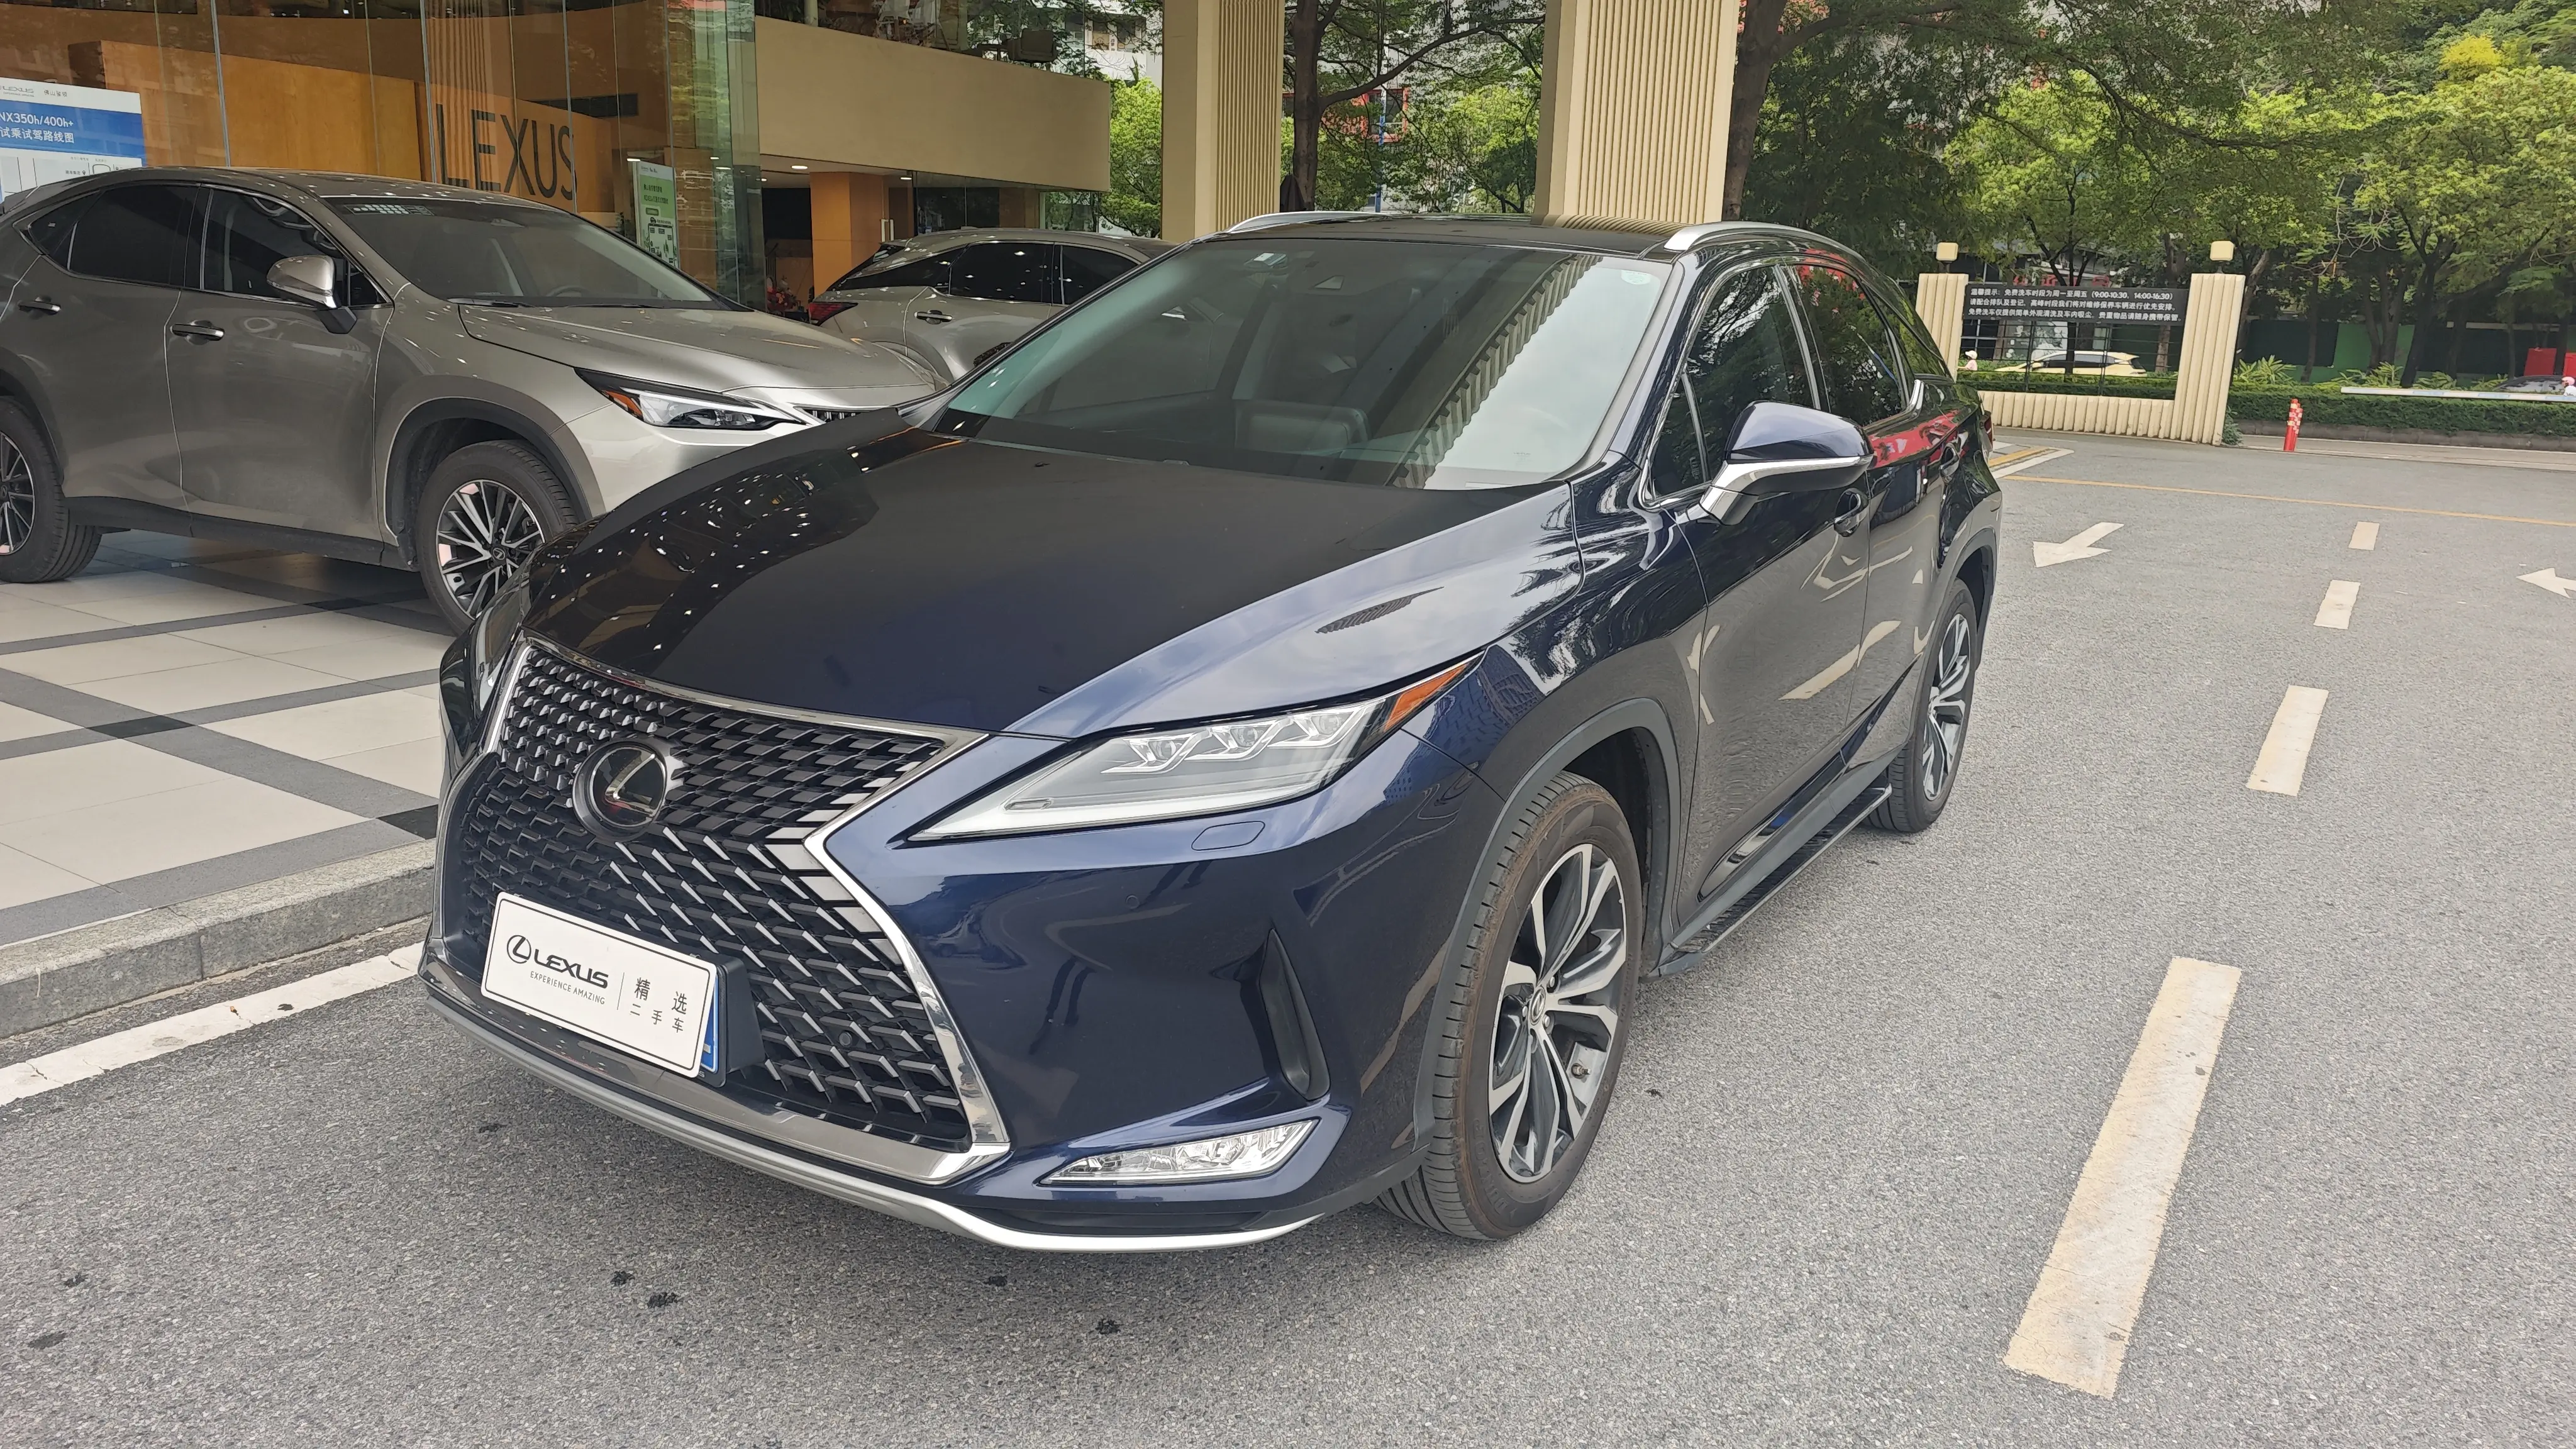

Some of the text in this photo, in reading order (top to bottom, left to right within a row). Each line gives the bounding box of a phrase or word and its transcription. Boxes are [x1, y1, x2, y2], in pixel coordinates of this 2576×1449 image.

[0, 111, 74, 128] NX350h/400h+
[0, 126, 74, 143] 试乘试驾路线图
[436, 103, 577, 200] LEXUS
[534, 948, 609, 989] LEXUS
[530, 970, 606, 1005] EXPERIENCE AMAZING
[634, 977, 687, 1014] 精选
[630, 1003, 684, 1033] 二手车
